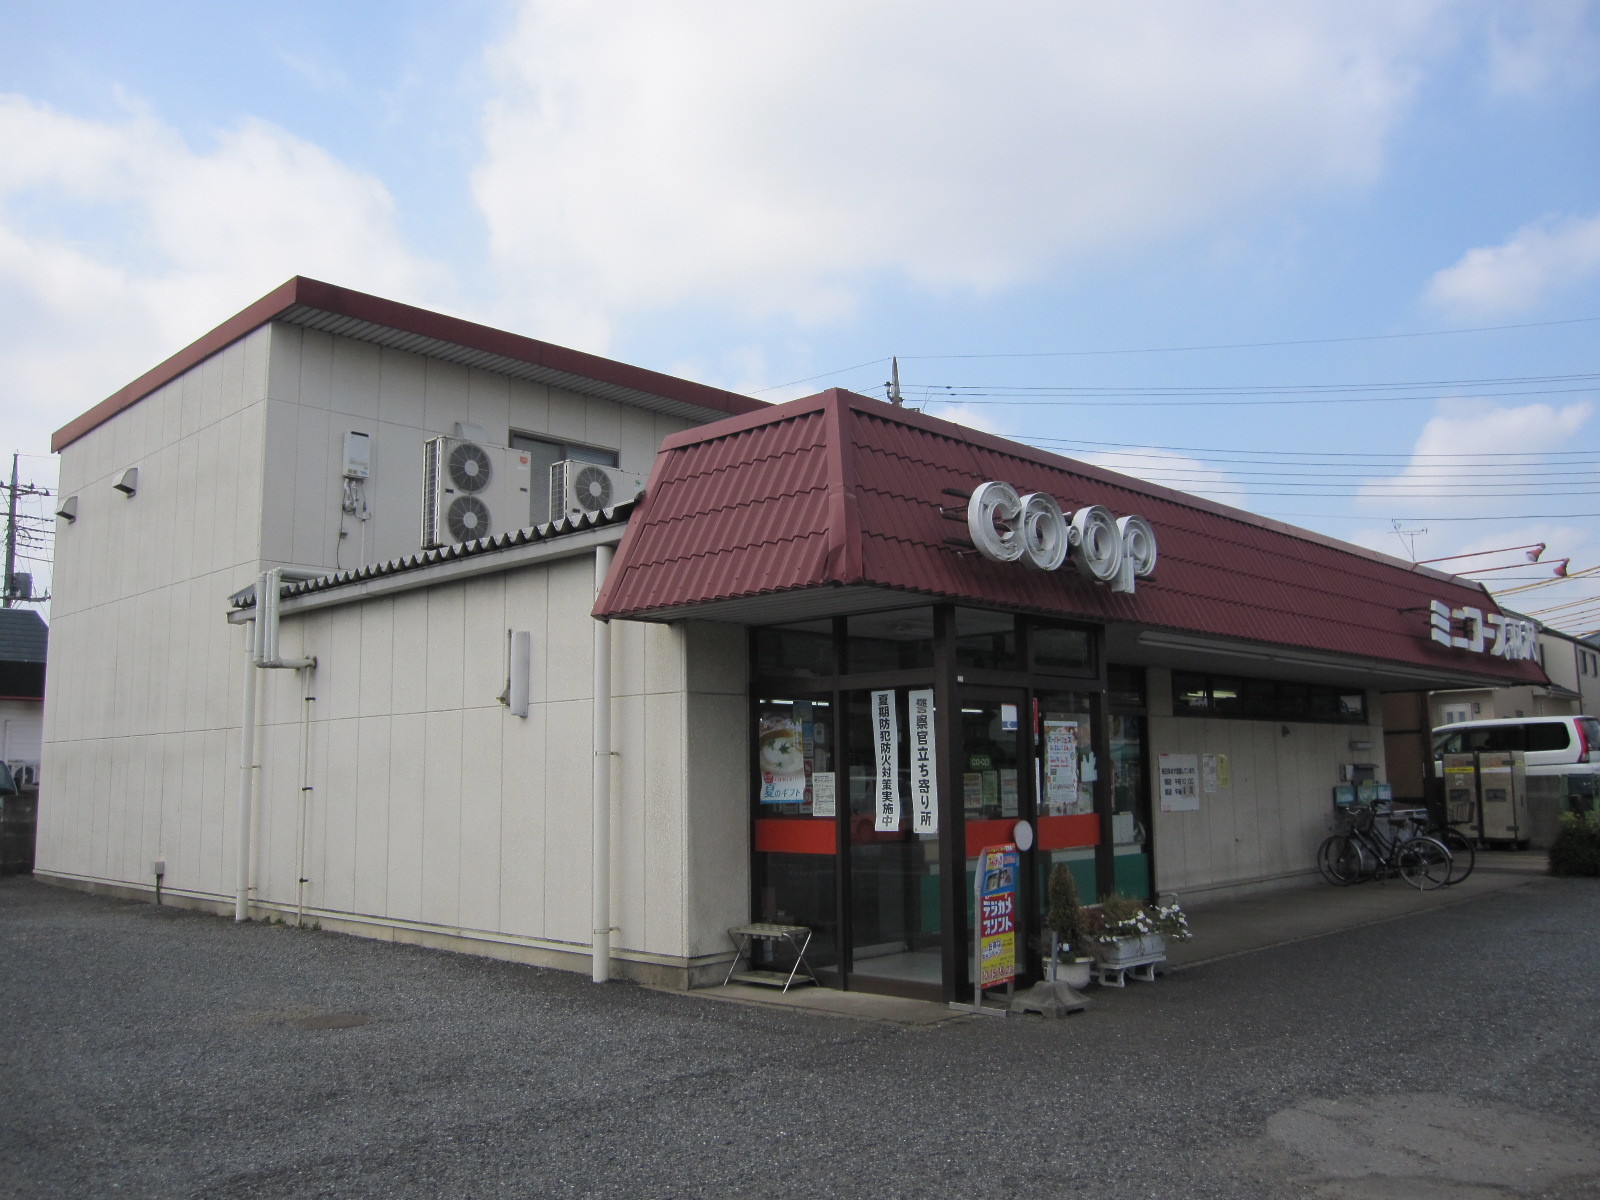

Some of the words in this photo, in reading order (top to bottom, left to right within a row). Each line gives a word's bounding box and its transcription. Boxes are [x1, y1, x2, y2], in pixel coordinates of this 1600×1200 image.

[877, 694, 893, 827] 夏期防犯防火対策実施中
[916, 698, 931, 826] 警察官立ち寄り所
[764, 783, 800, 798] 夏のギフト
[983, 898, 1012, 918] デジカメ
[983, 917, 1013, 935] プリント
